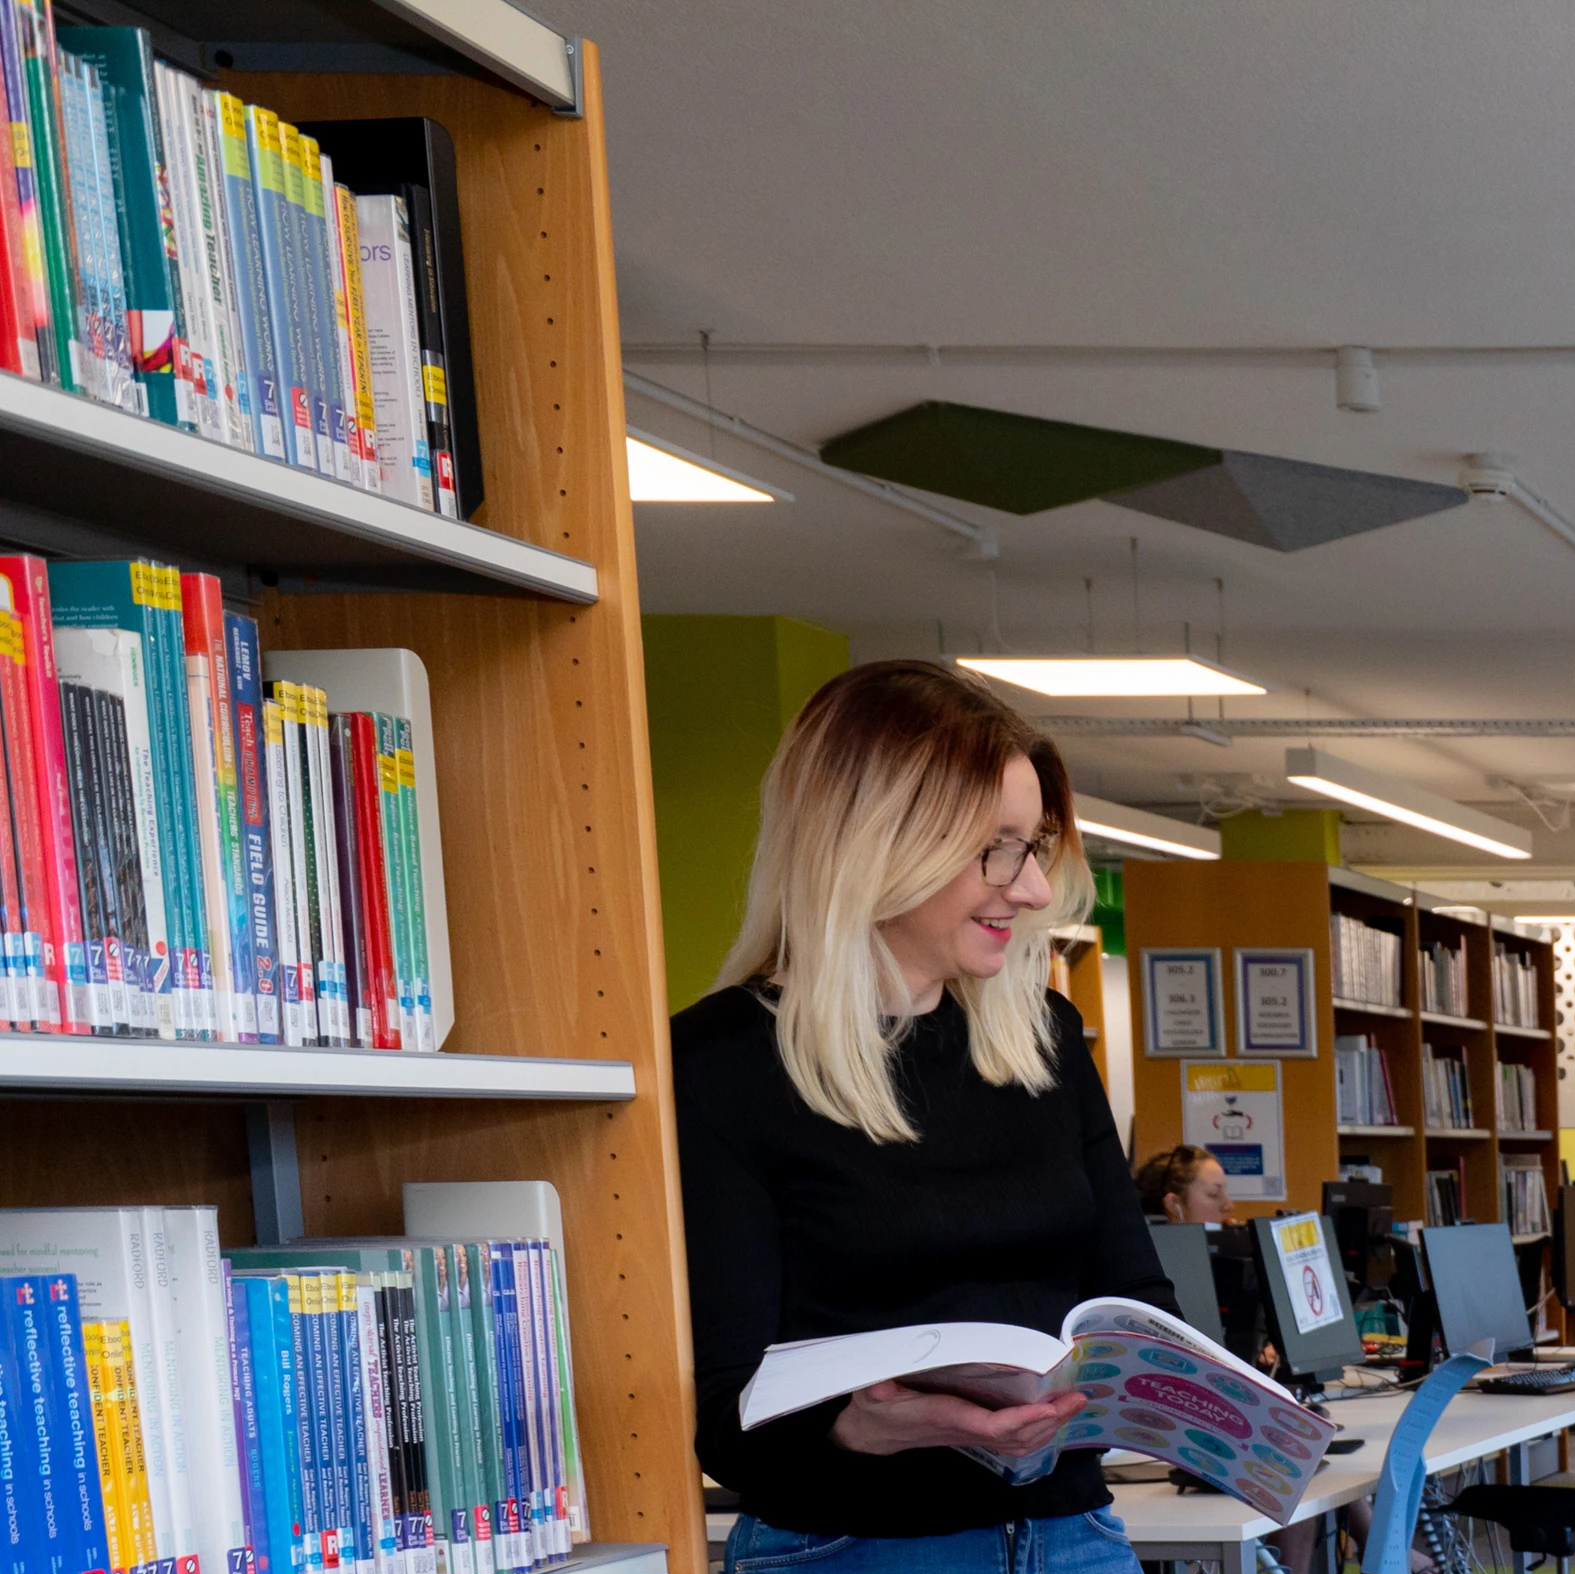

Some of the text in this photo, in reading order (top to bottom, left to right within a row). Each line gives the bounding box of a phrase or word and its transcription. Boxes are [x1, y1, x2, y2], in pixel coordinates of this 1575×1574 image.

[206, 234, 222, 307] Teacher
[403, 253, 412, 296] LEARNING
[252, 233, 266, 310] LEARNING
[263, 316, 274, 371] WORKS
[345, 222, 353, 267] SURVIVE
[357, 349, 367, 394] TEACHIN
[407, 298, 417, 337] MENTORS
[413, 356, 422, 398] SCHOOLS
[241, 641, 251, 681] LEMOV
[144, 769, 154, 817] Teaching
[216, 655, 226, 698] NATIONAL
[232, 839, 242, 895] STANDARDS
[148, 820, 158, 876] Experience
[248, 834, 273, 993] FIELD GUIDE 2.0
[90, 946, 102, 964] 7
[130, 1232, 145, 1290] RADFORD
[154, 1231, 168, 1288] RADFORD
[380, 1341, 388, 1369] Activist
[241, 1347, 256, 1439] TEACHING ADULTS
[281, 1350, 293, 1415] Bill Rogers
[292, 1313, 312, 1463] COMING AN EFFECTIVE TEACHER
[382, 1370, 390, 1403] Teaching
[397, 1367, 405, 1400] Teaching
[401, 1402, 409, 1443] Profession
[1138, 1377, 1245, 1427] TEACHING
[1156, 1389, 1228, 1423] TODAY
[24, 1310, 57, 1539] reflective teaching in schools
[57, 1305, 92, 1532] reflective teaching in schools
[386, 1405, 394, 1448] Profession
[98, 1427, 110, 1477] TEACHER
[152, 1431, 164, 1478] ACTION
[232, 1552, 243, 1570] 7
